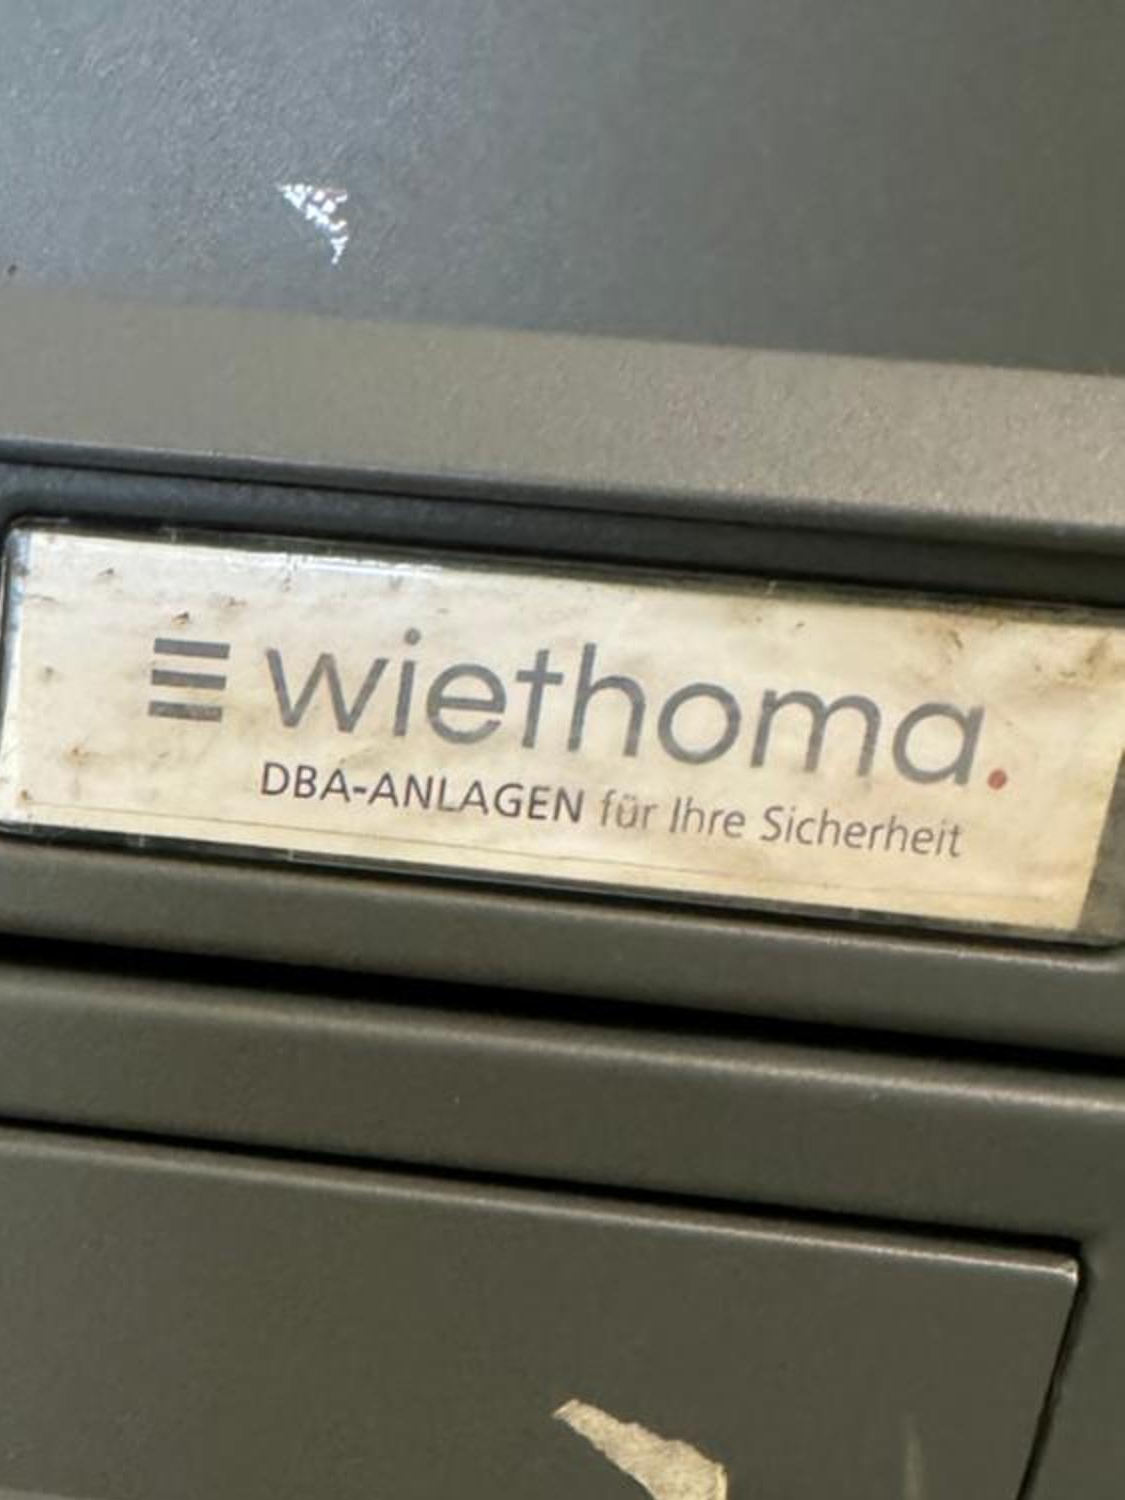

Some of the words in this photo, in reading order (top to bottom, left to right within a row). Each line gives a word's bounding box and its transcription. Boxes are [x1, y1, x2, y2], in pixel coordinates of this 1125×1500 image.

[260, 761, 584, 823] DBA-ANLAGEN
[599, 788, 657, 830] für
[668, 796, 746, 839] Ihre
[760, 805, 964, 859] Sicherheit
